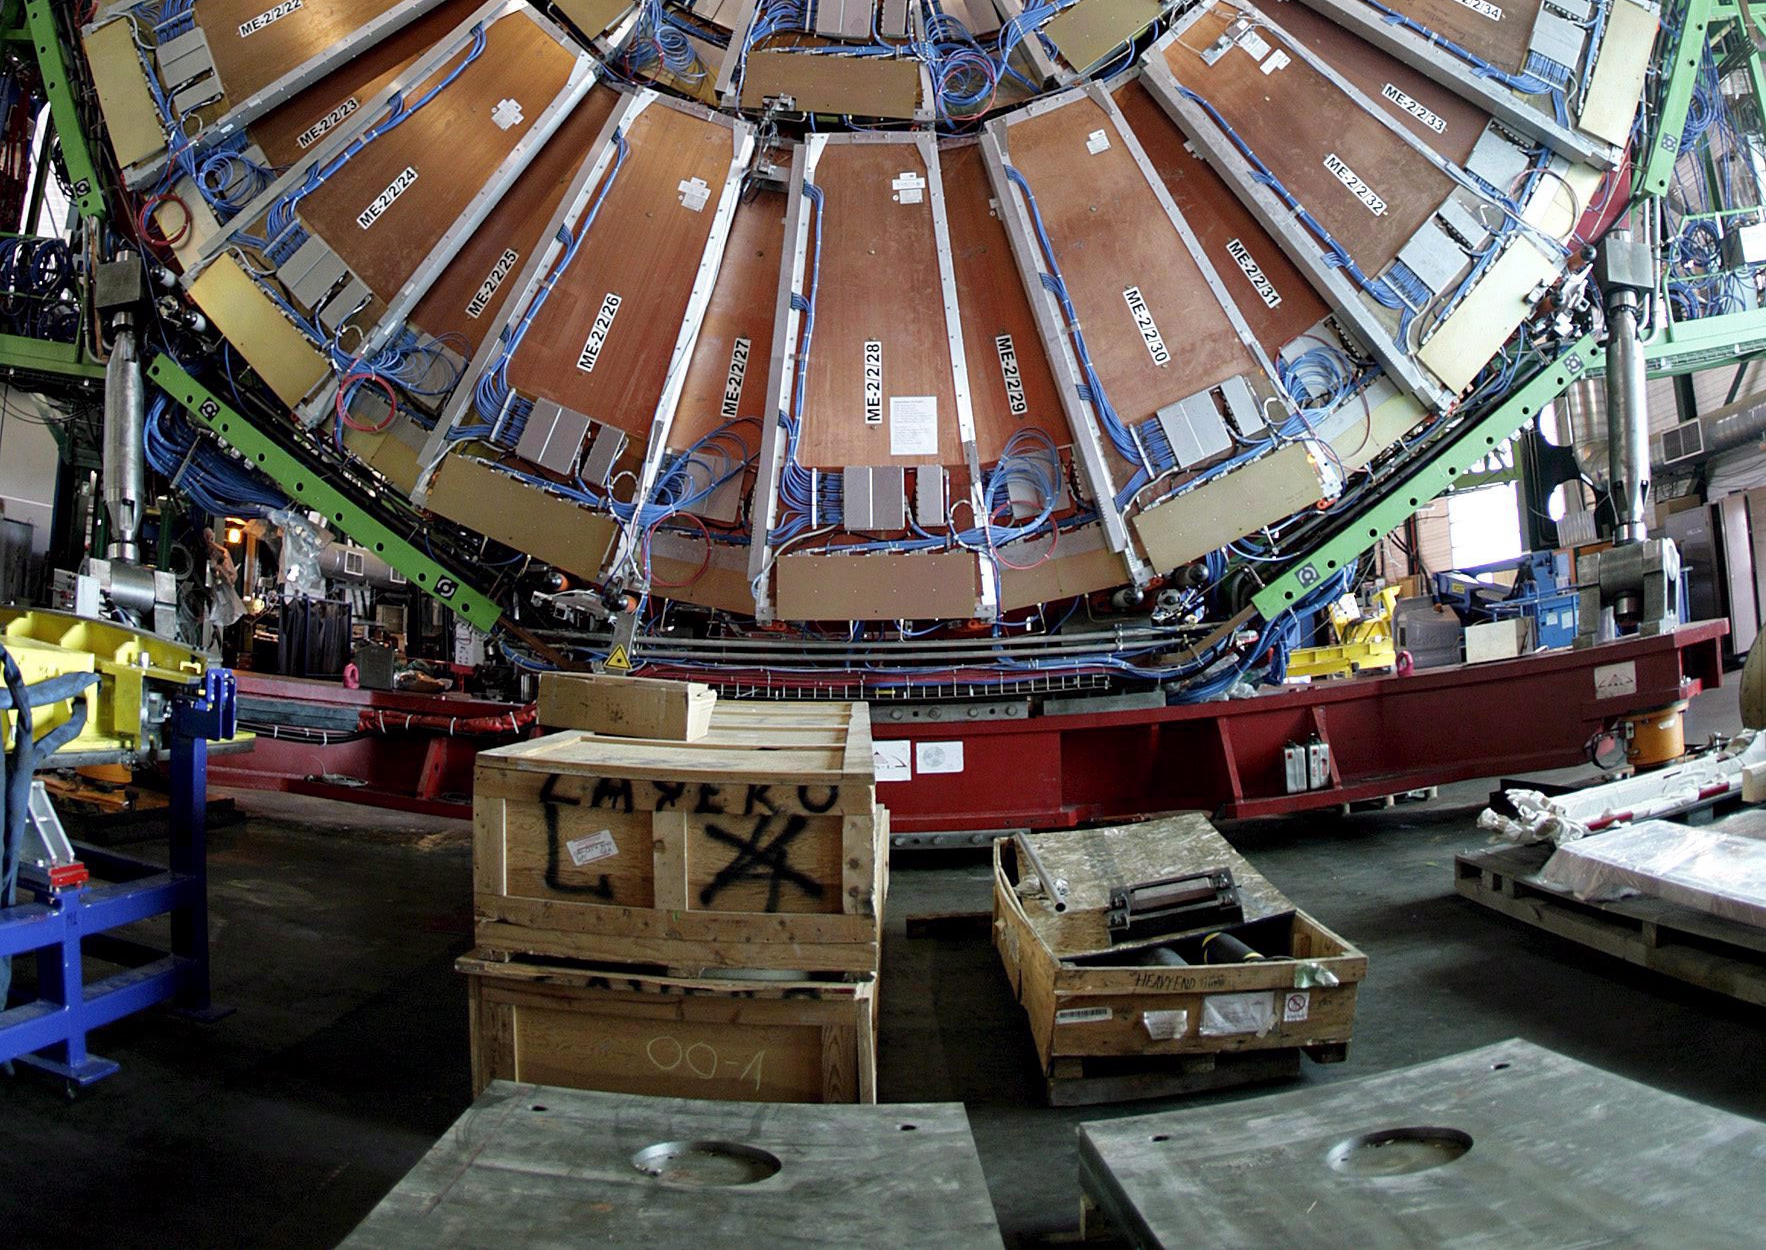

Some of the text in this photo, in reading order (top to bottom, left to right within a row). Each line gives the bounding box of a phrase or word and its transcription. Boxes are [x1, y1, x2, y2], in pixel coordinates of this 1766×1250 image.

[299, 99, 358, 147] ME-2/2/23
[1384, 86, 1444, 131] ME-2/2/33
[359, 170, 416, 228] ME-2/2/24
[1326, 155, 1384, 213] ME-2/2/32
[468, 251, 516, 316] ME-2/2/25
[1228, 241, 1279, 306] ME-2/2/31
[580, 296, 618, 369] ME-2/2/26
[1126, 289, 1167, 362] ME-2/2/30
[724, 340, 749, 416] ME-2/2/27
[867, 343, 880, 423] ME-2/2/28
[998, 336, 1024, 413] ME-2/2/29
